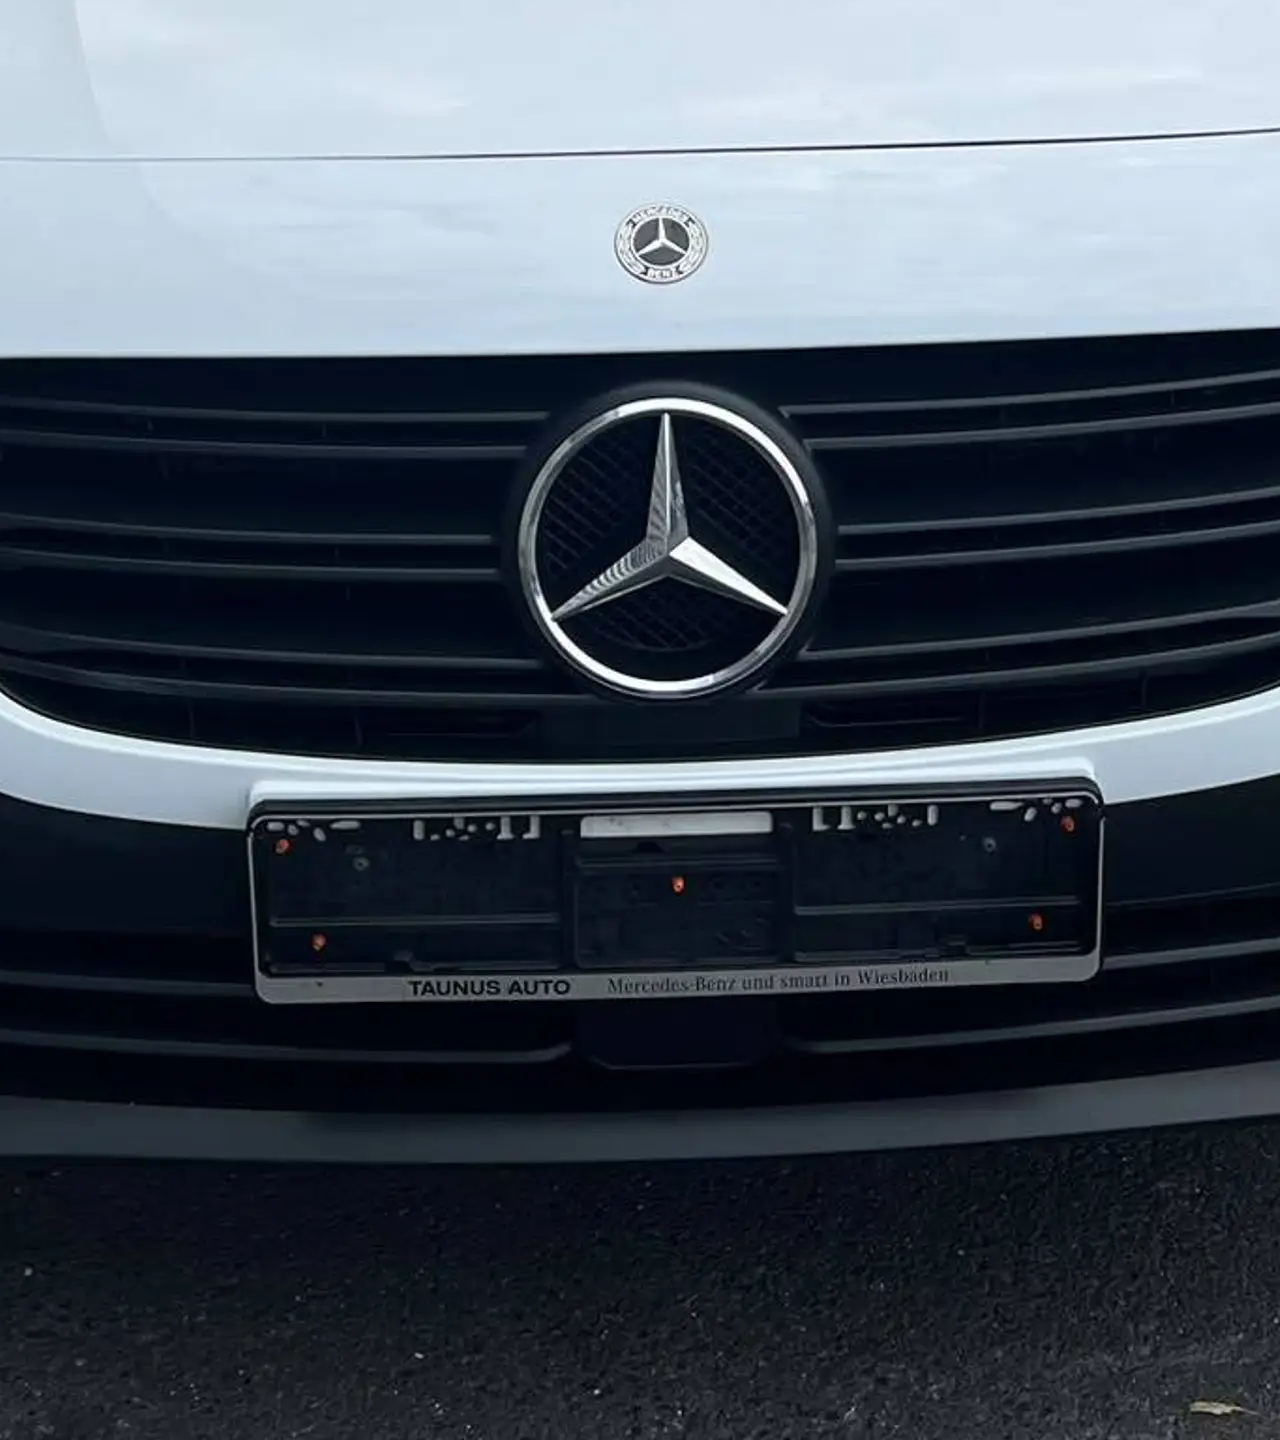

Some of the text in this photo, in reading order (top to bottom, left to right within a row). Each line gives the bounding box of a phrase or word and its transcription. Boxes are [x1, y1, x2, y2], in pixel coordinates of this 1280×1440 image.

[408, 978, 571, 997] TAUNUS AUTO
[608, 968, 950, 994] Mercedes-Benz und smart in Wiesbaden
